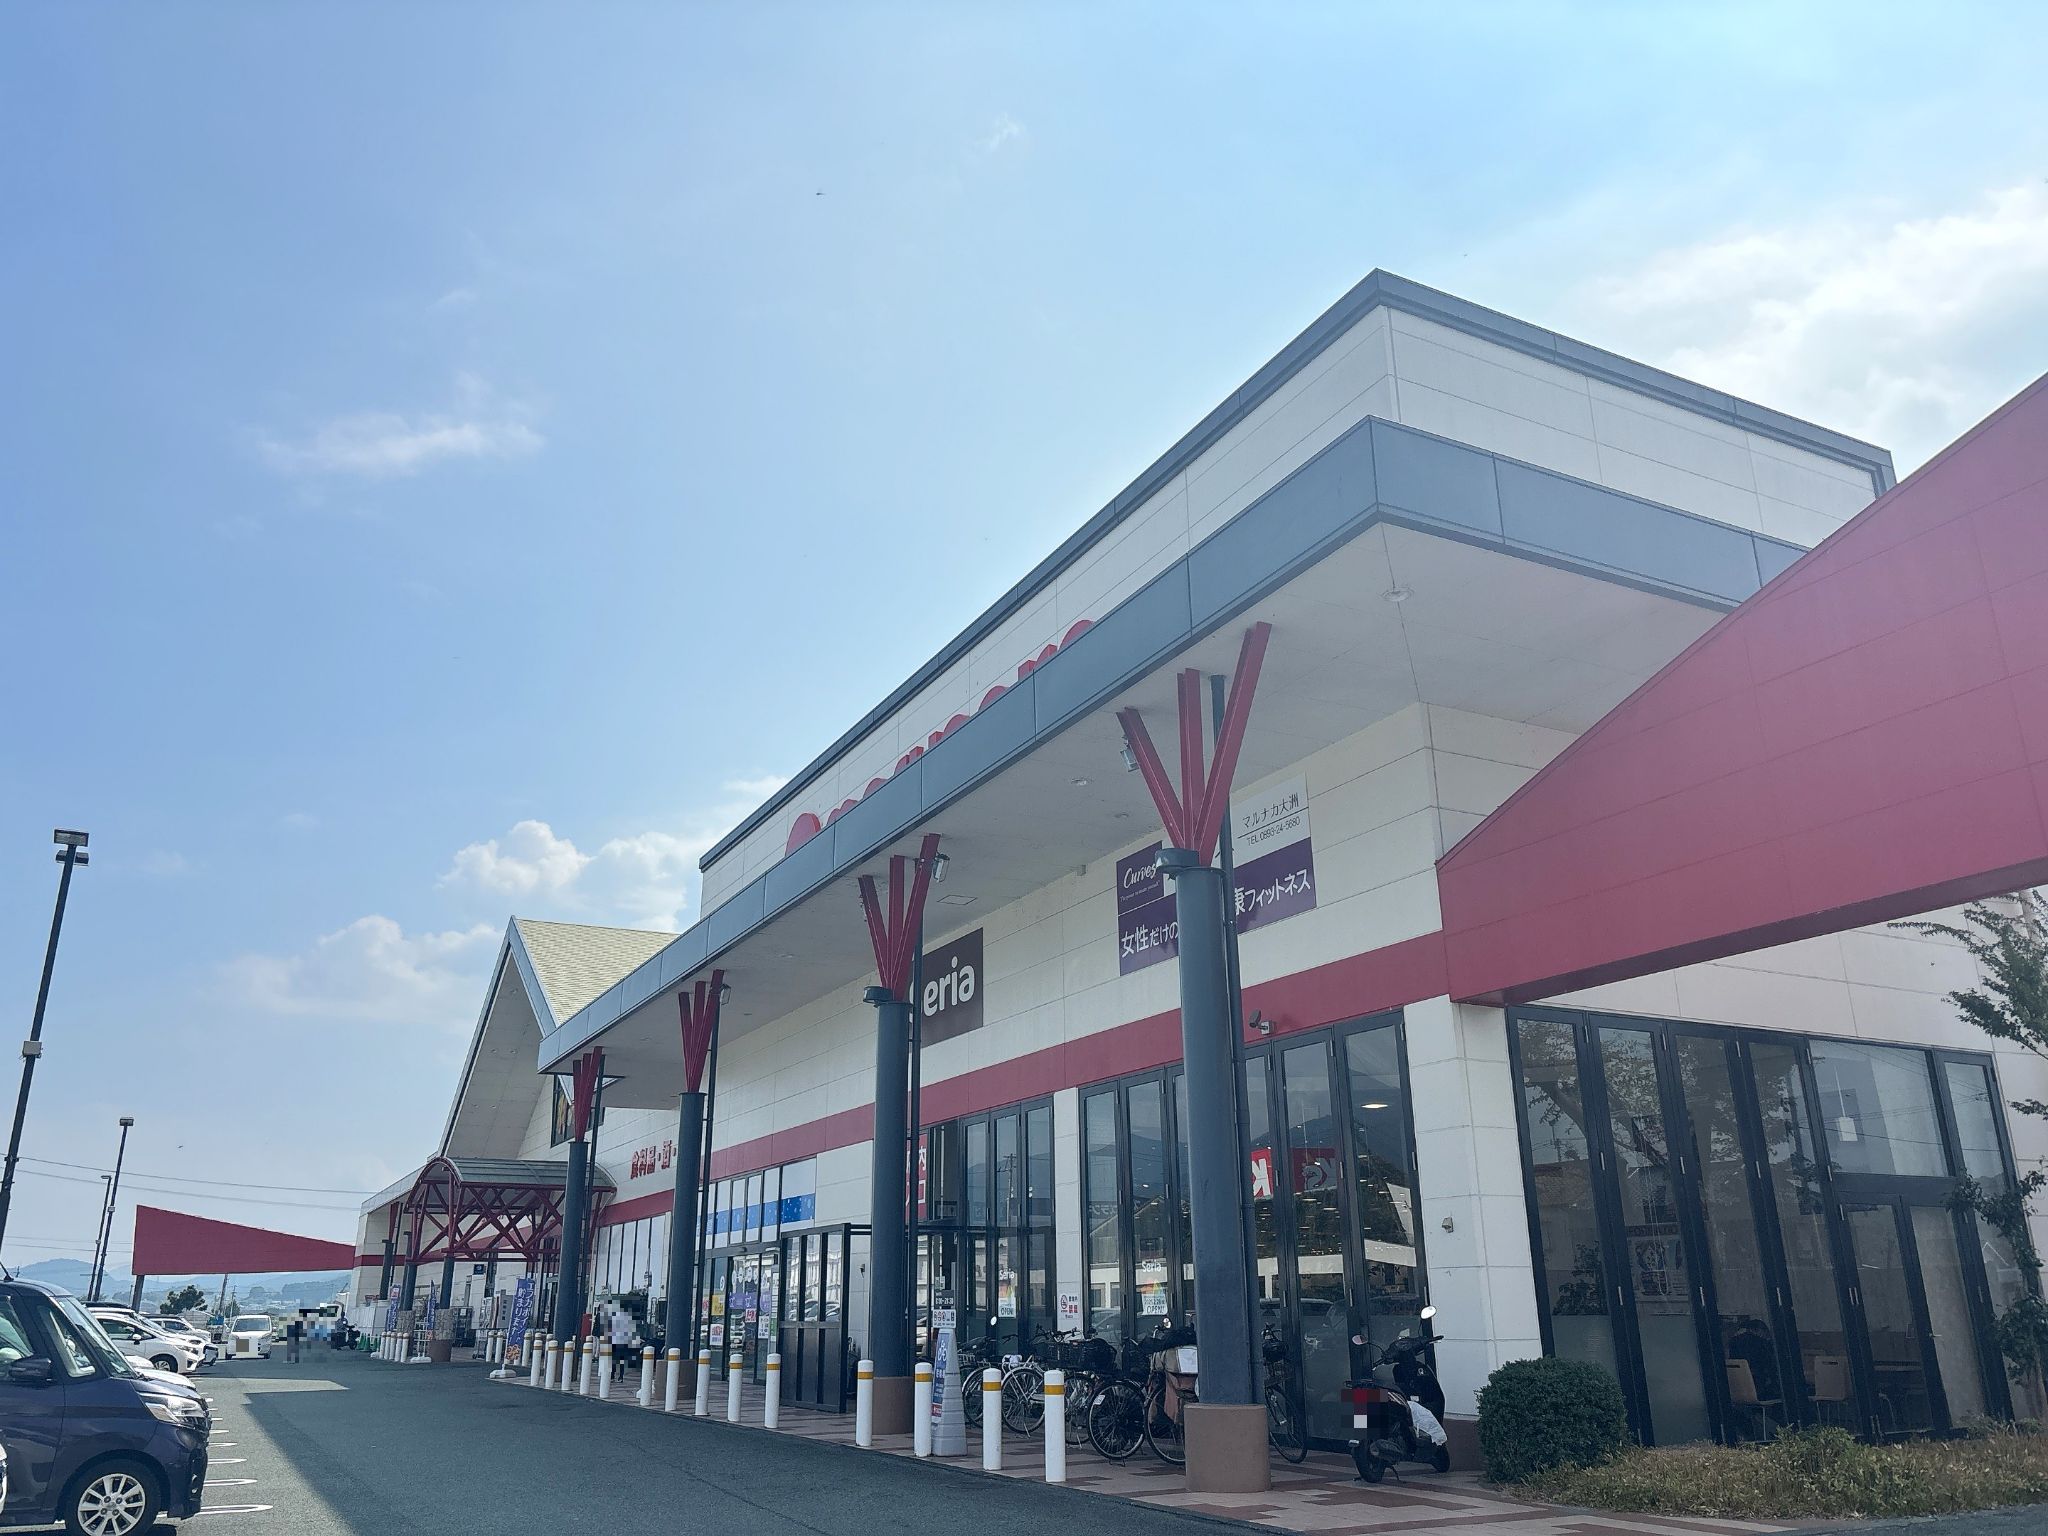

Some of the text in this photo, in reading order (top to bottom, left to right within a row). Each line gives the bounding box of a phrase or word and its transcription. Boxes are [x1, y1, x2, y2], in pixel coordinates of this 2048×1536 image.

[1242, 792, 1299, 828] マルナカ大洲
[1123, 863, 1157, 889] Curves
[1121, 921, 1179, 958] 女性だけの
